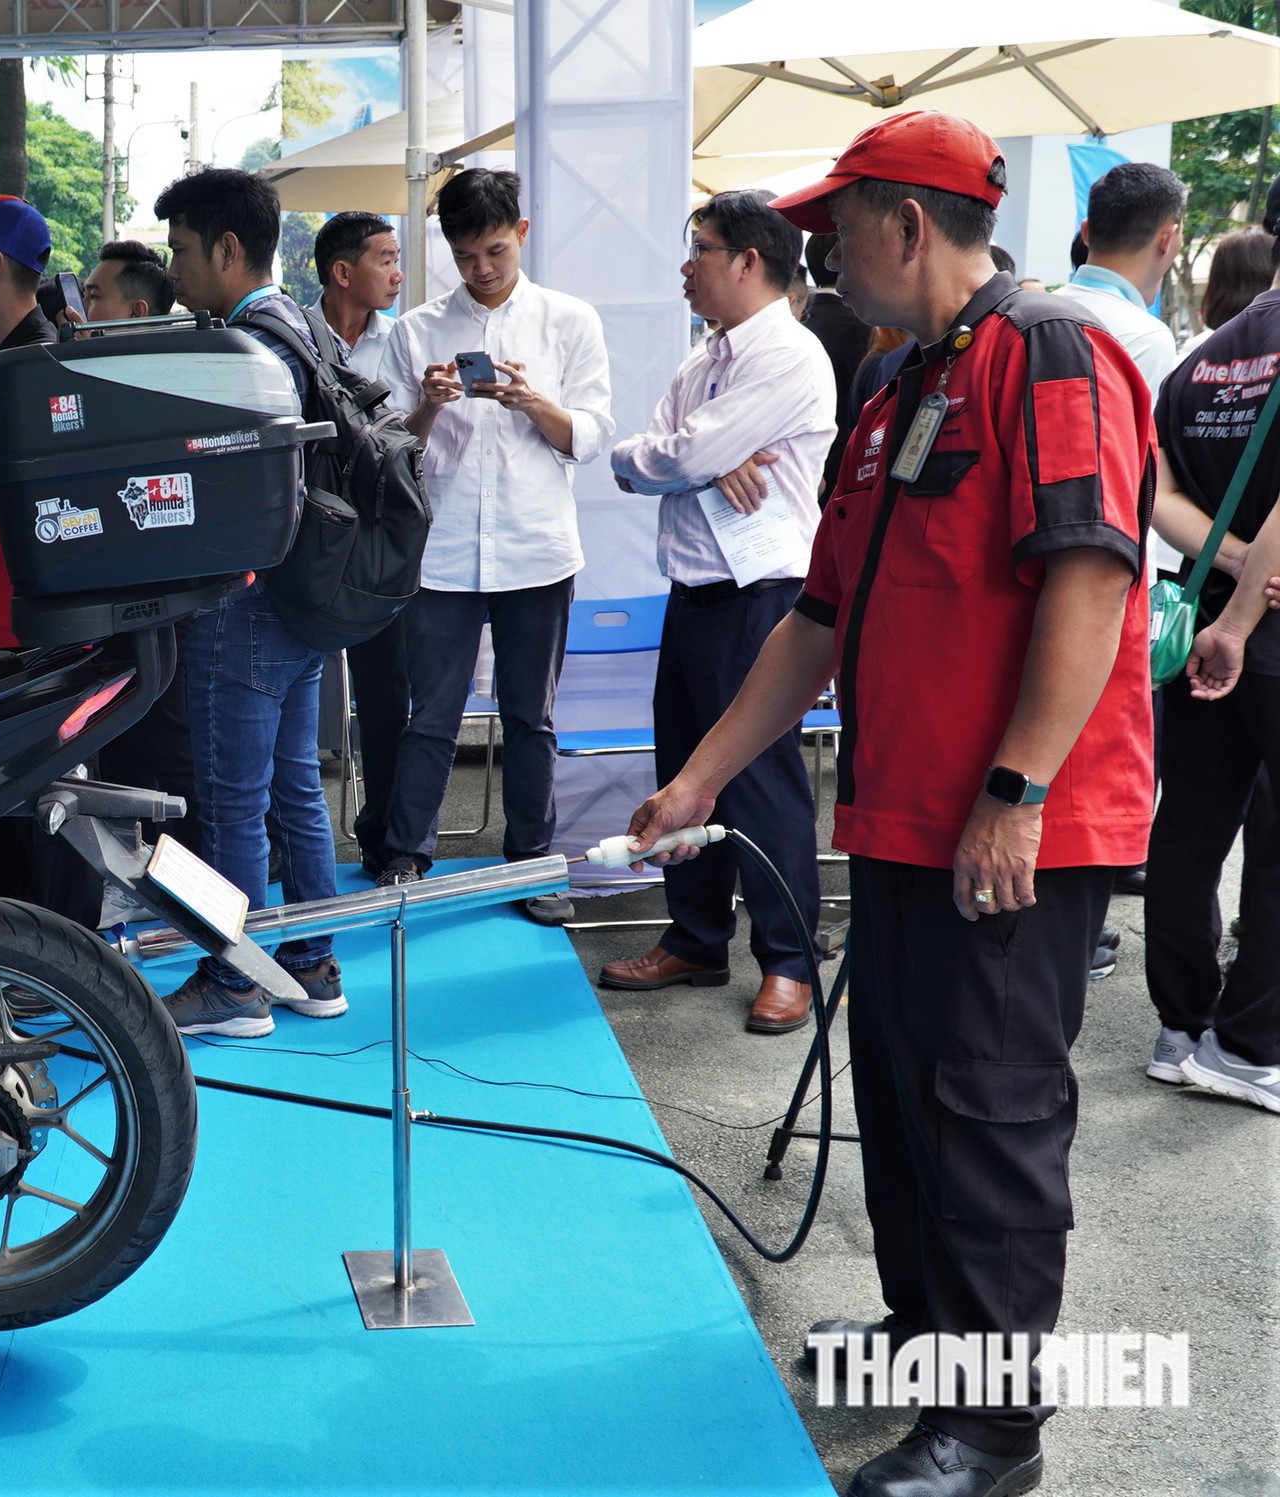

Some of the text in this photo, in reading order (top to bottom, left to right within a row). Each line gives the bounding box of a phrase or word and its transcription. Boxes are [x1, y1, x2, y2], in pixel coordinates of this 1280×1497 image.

[52, 410, 79, 423] Honda
[53, 420, 80, 433] Bikers
[149, 477, 183, 499] +84
[149, 497, 185, 512] Honda
[150, 511, 186, 525] Bikers
[63, 523, 99, 536] COFFEE
[121, 601, 161, 621] GIVI
